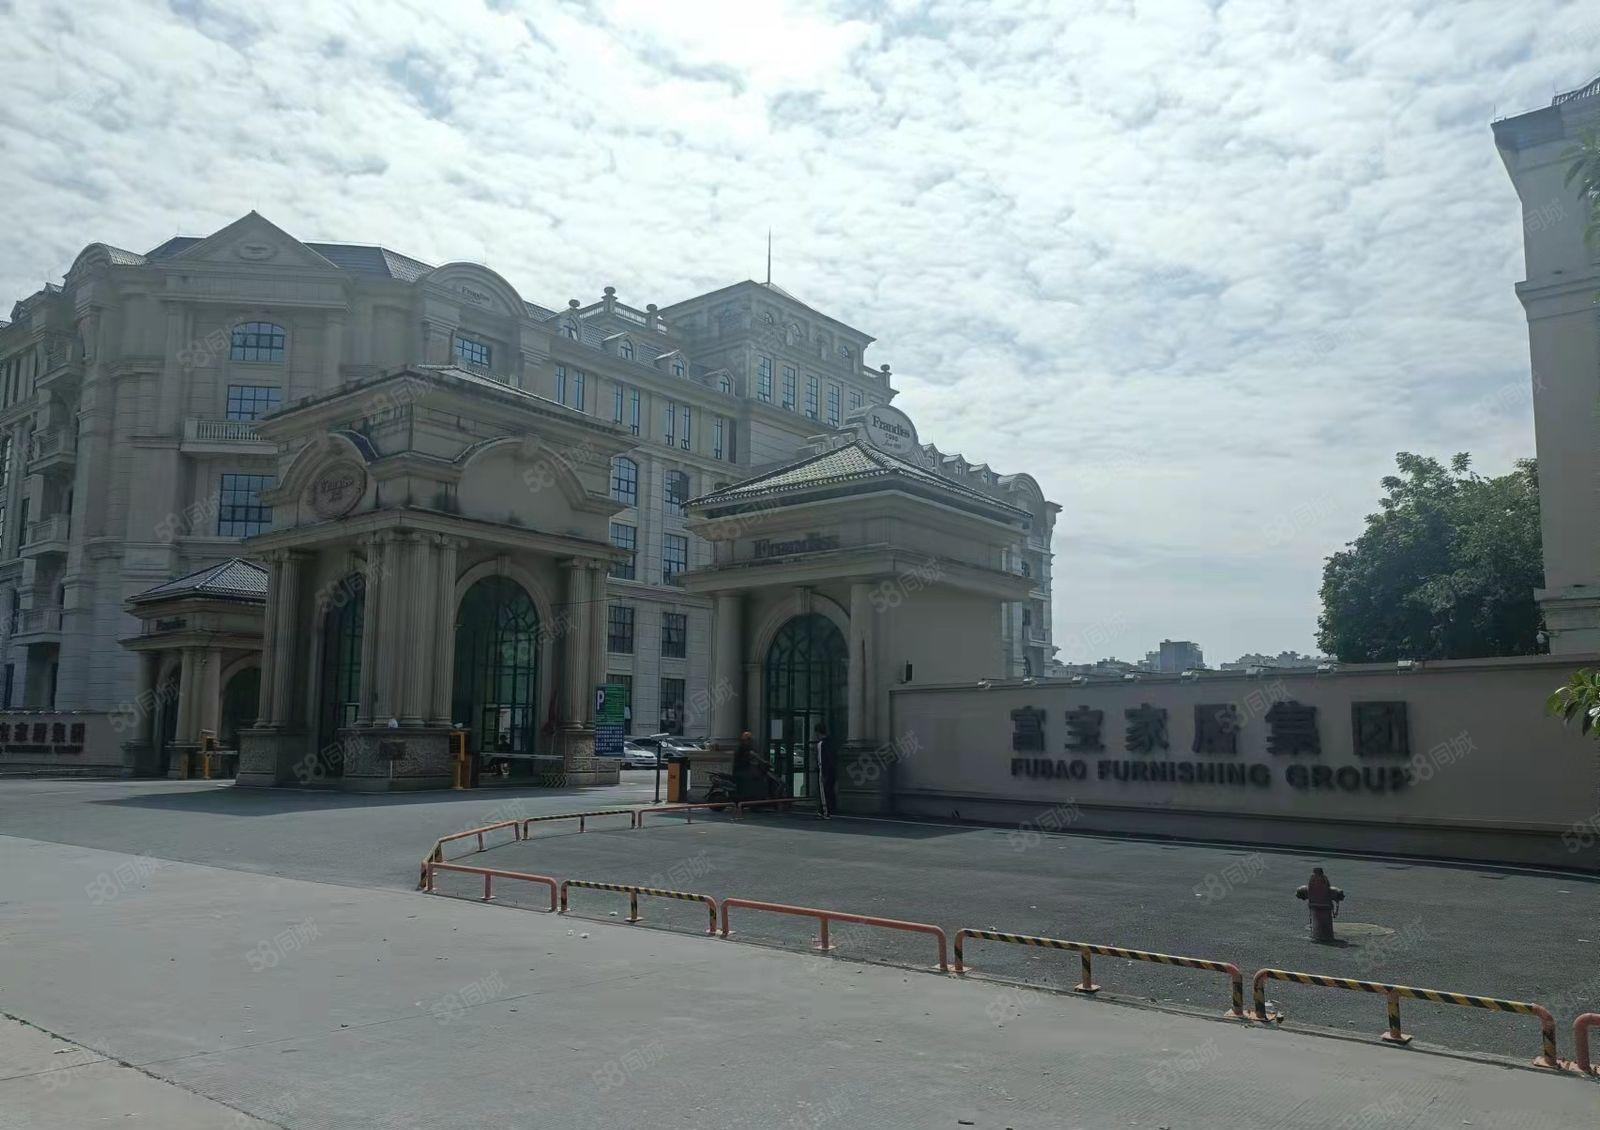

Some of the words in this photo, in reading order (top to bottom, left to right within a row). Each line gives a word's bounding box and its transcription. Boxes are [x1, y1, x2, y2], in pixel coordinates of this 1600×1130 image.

[1011, 758, 1088, 781] FUBAO
[1097, 759, 1272, 787] FURNISHING
[1285, 763, 1408, 793] GROUP
